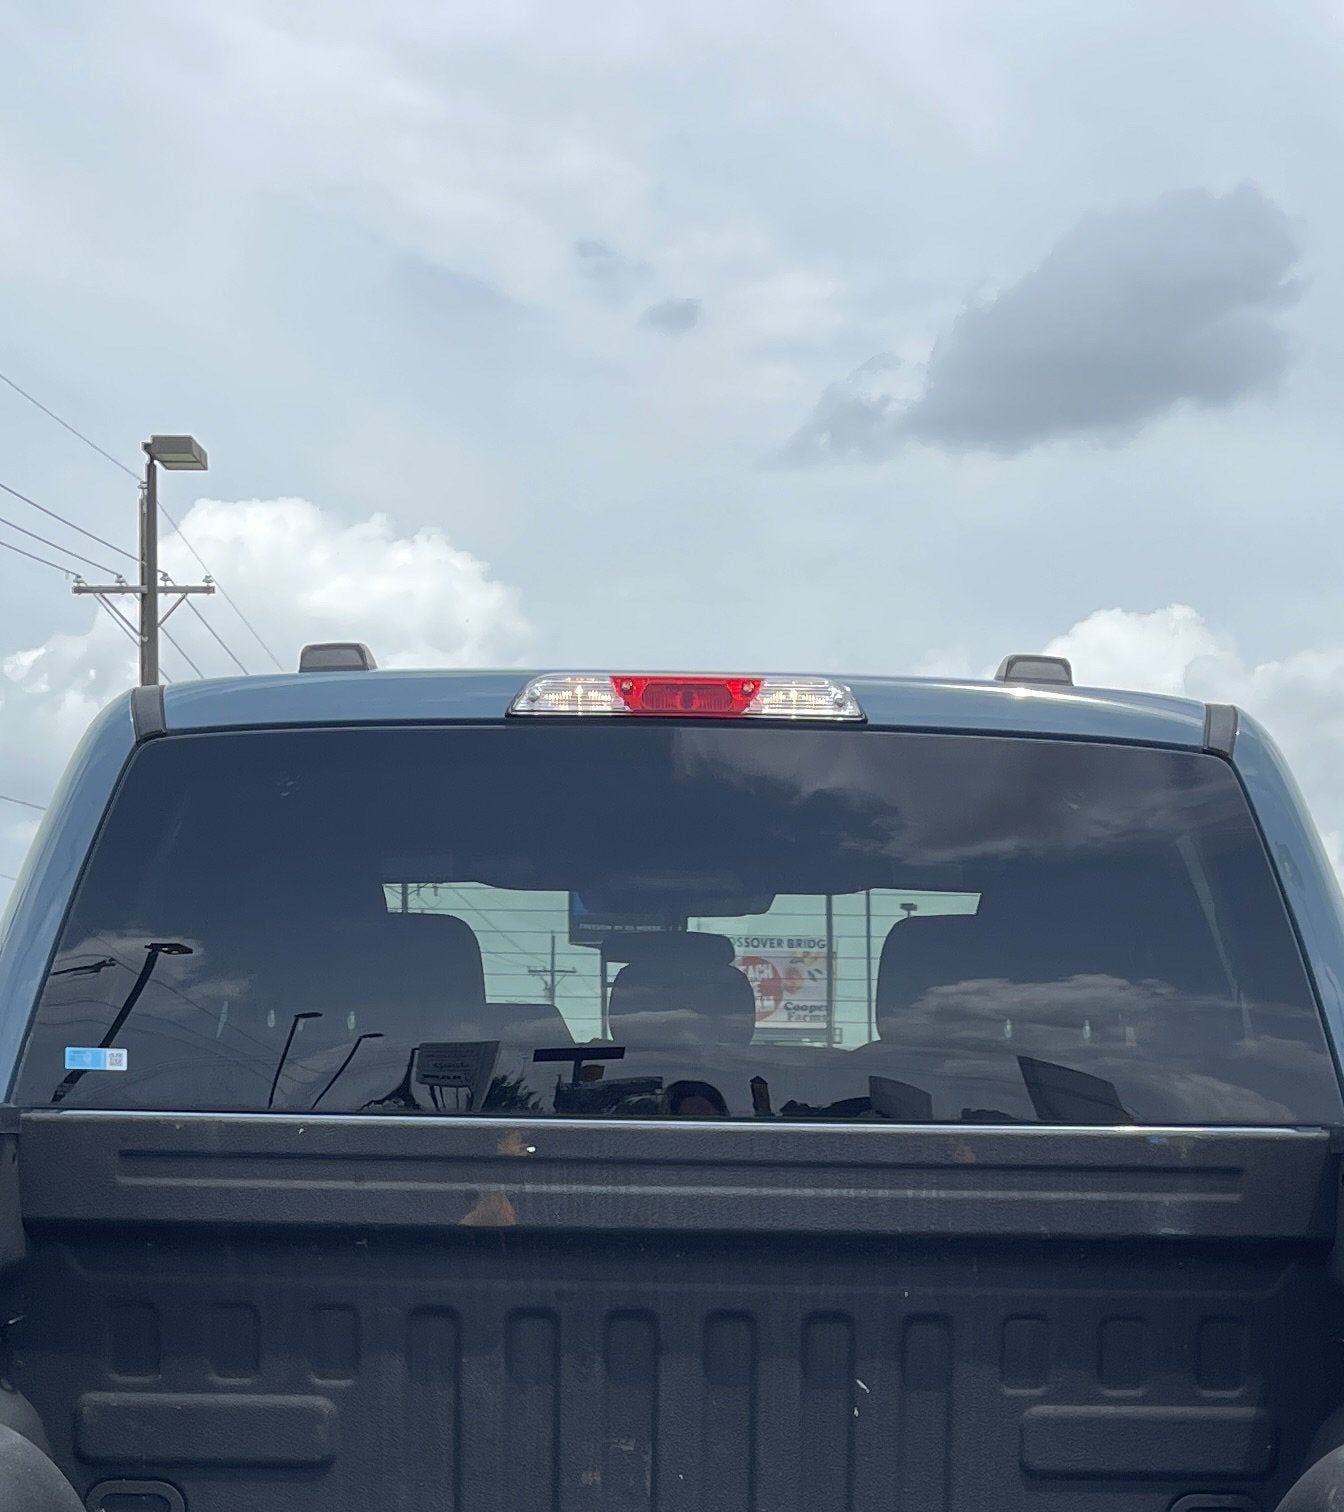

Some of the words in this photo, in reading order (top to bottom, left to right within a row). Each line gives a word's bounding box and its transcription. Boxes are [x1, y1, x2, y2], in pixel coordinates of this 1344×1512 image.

[728, 936, 783, 949] OSSOVER
[786, 939, 827, 949] BRIDG
[783, 1001, 827, 1014] Coope
[787, 1011, 827, 1022] Farm
